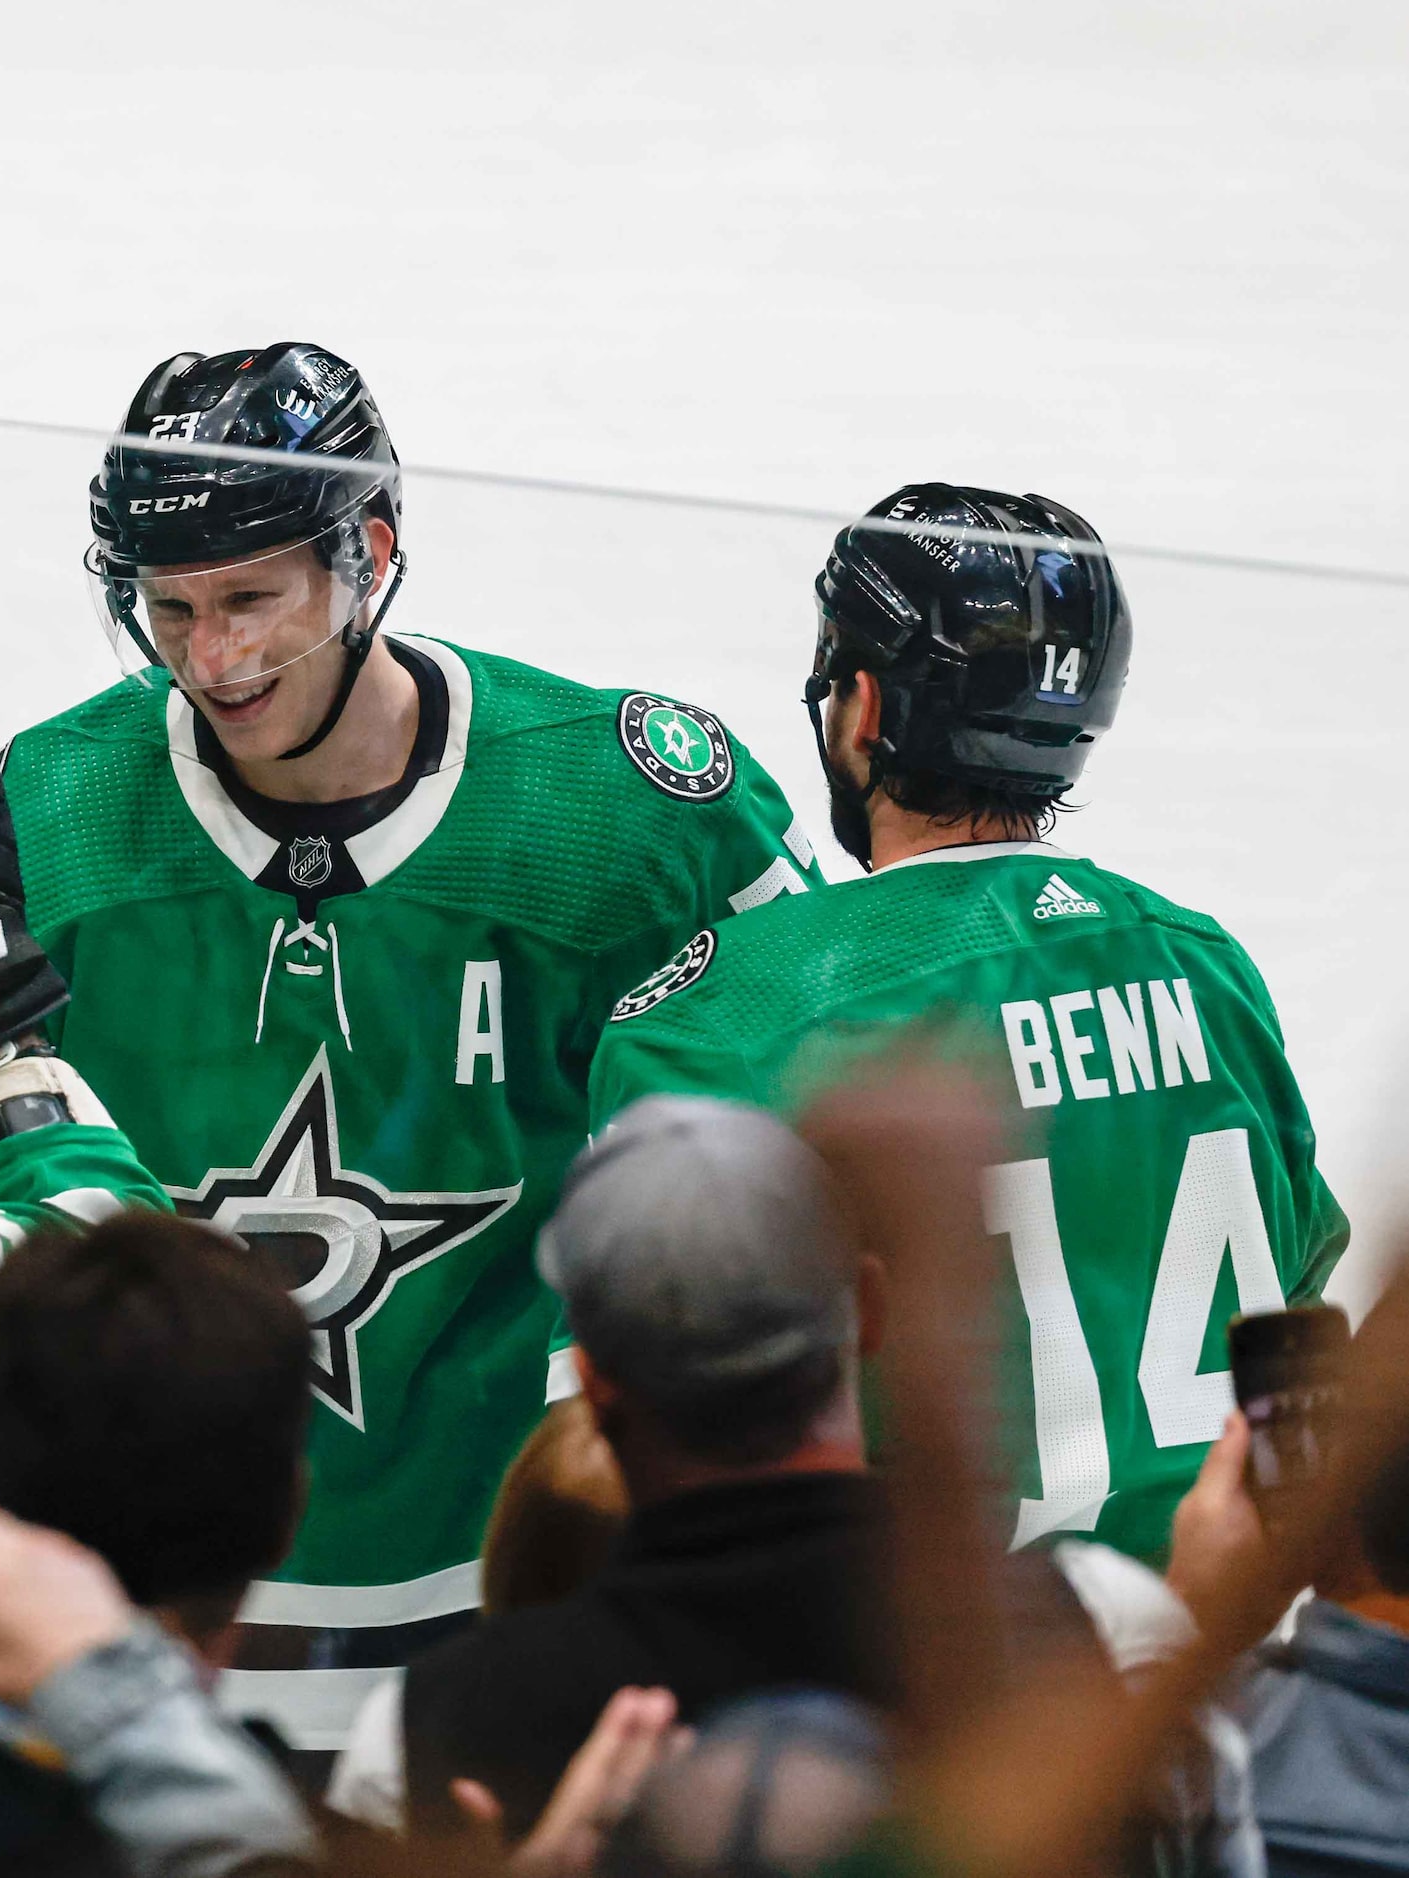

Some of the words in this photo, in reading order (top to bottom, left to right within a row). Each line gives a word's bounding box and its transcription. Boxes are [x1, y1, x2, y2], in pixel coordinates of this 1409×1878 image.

[148, 411, 202, 446] 23
[129, 491, 212, 516] CCM
[1040, 644, 1081, 695] 14
[299, 849, 324, 878] NHL
[1033, 898, 1101, 920] adidas
[454, 960, 506, 1085] A
[1000, 977, 1212, 1109] BENN
[979, 1128, 1287, 1555] 14
